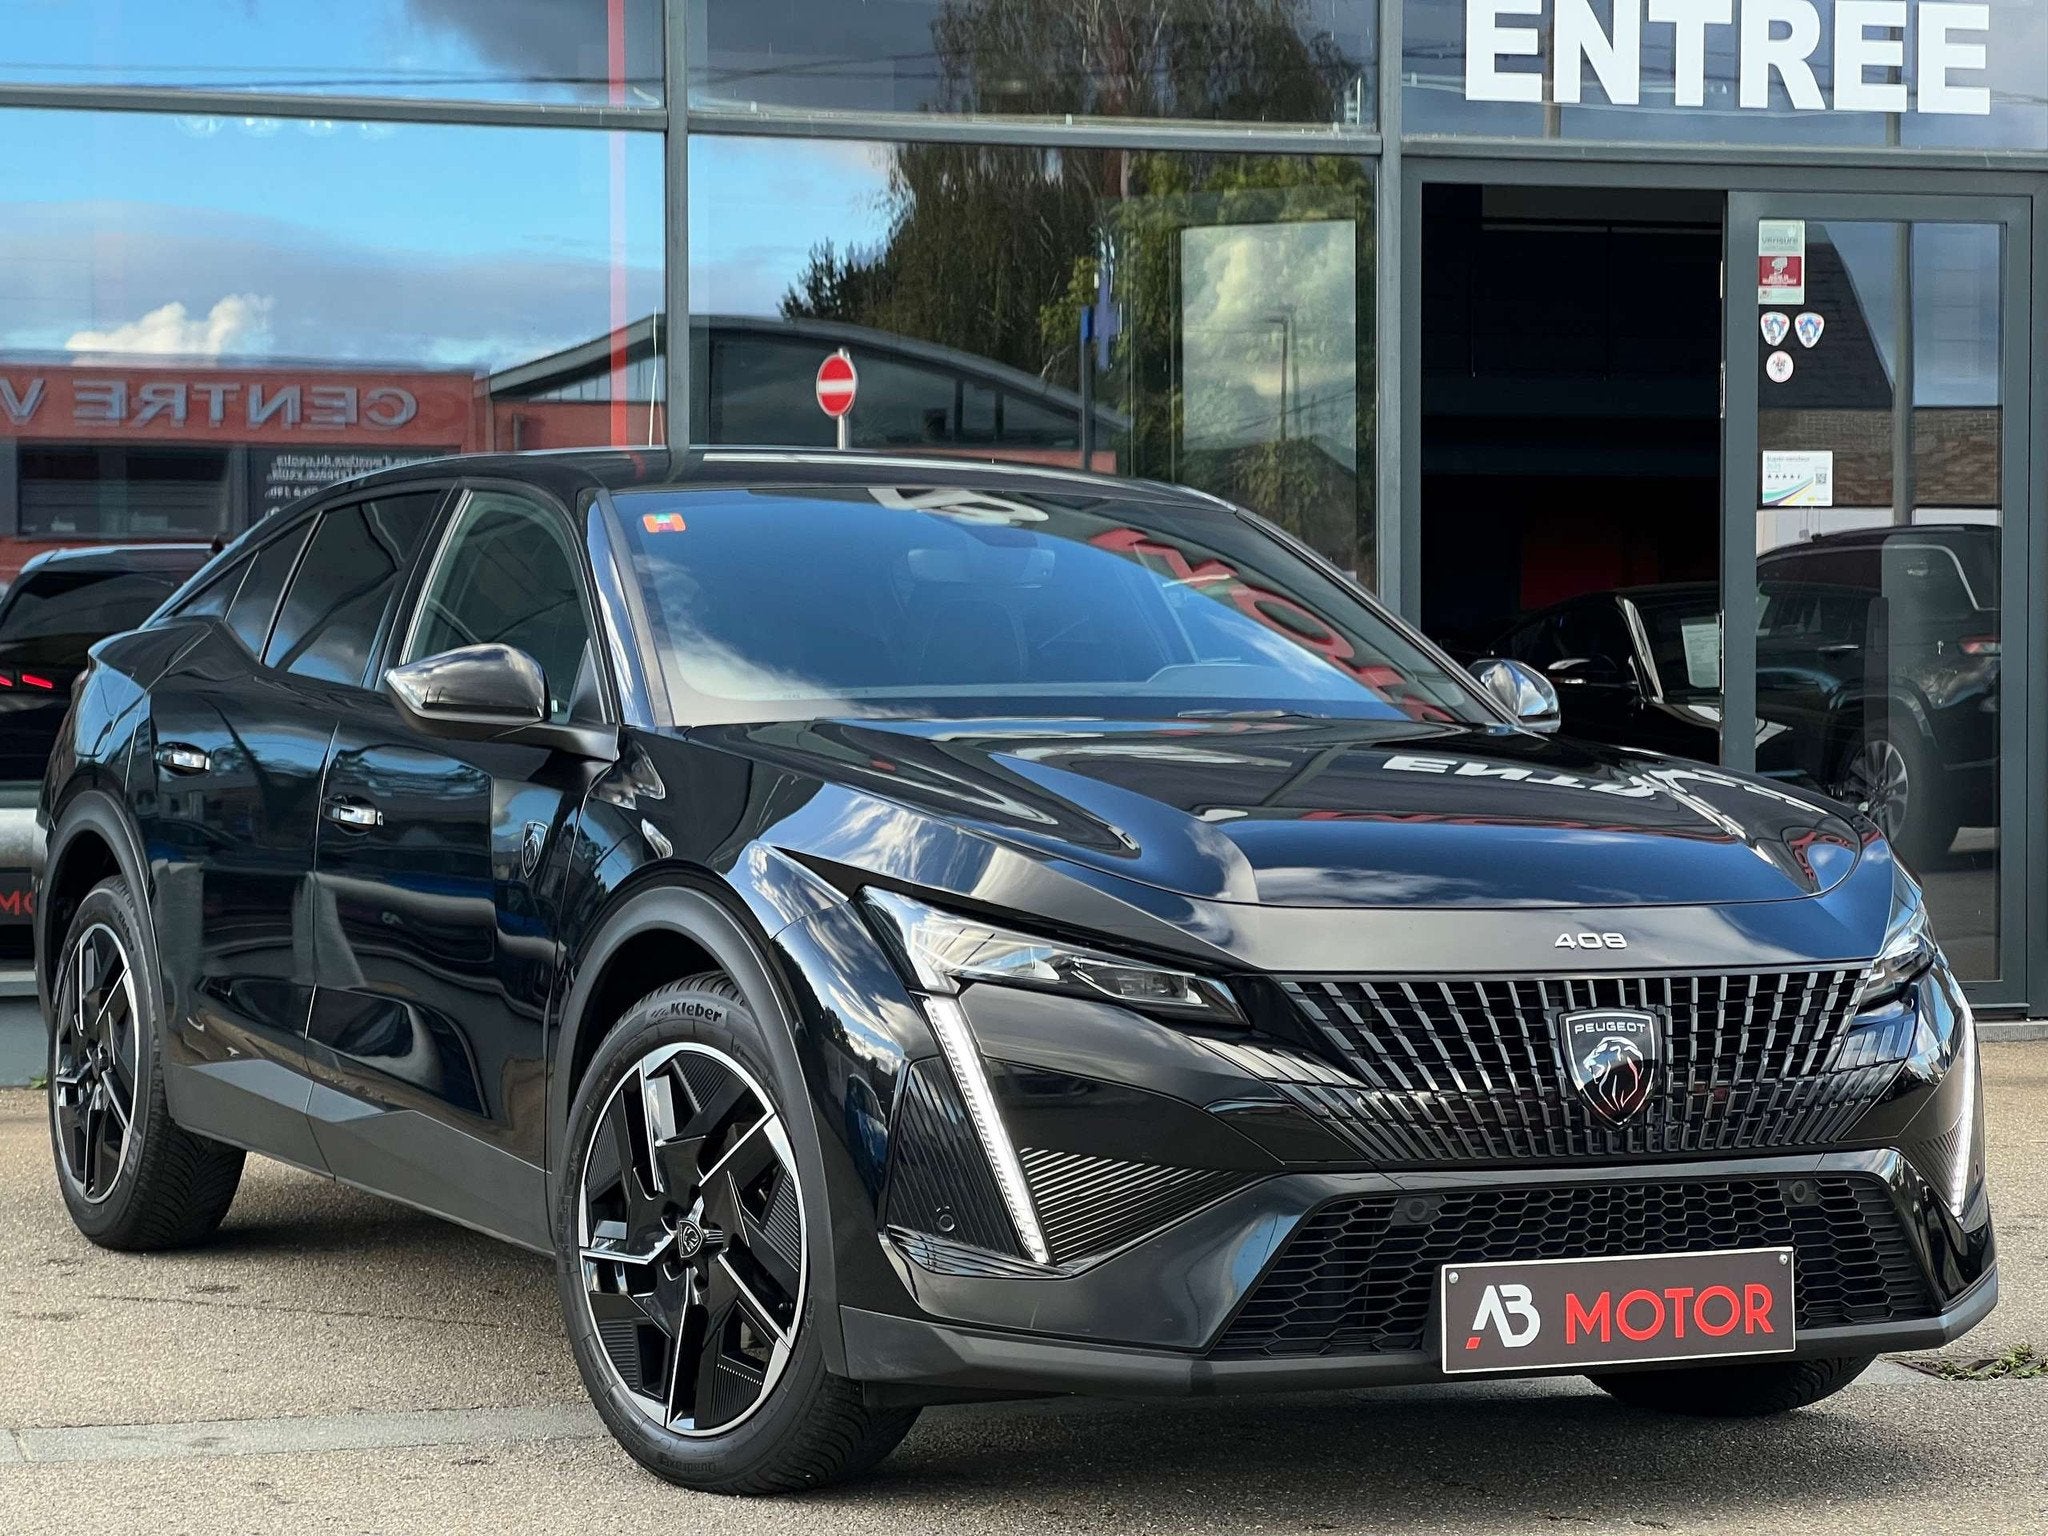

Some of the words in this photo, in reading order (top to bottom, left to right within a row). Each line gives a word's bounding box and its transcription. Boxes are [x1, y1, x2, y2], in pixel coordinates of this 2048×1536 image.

[1465, 0, 1990, 116] ENTREE
[1554, 932, 1629, 949] 408
[671, 1002, 723, 1022] Kleber
[1574, 1021, 1647, 1035] PEUGEOT
[1565, 1283, 1775, 1345] MOTOR
